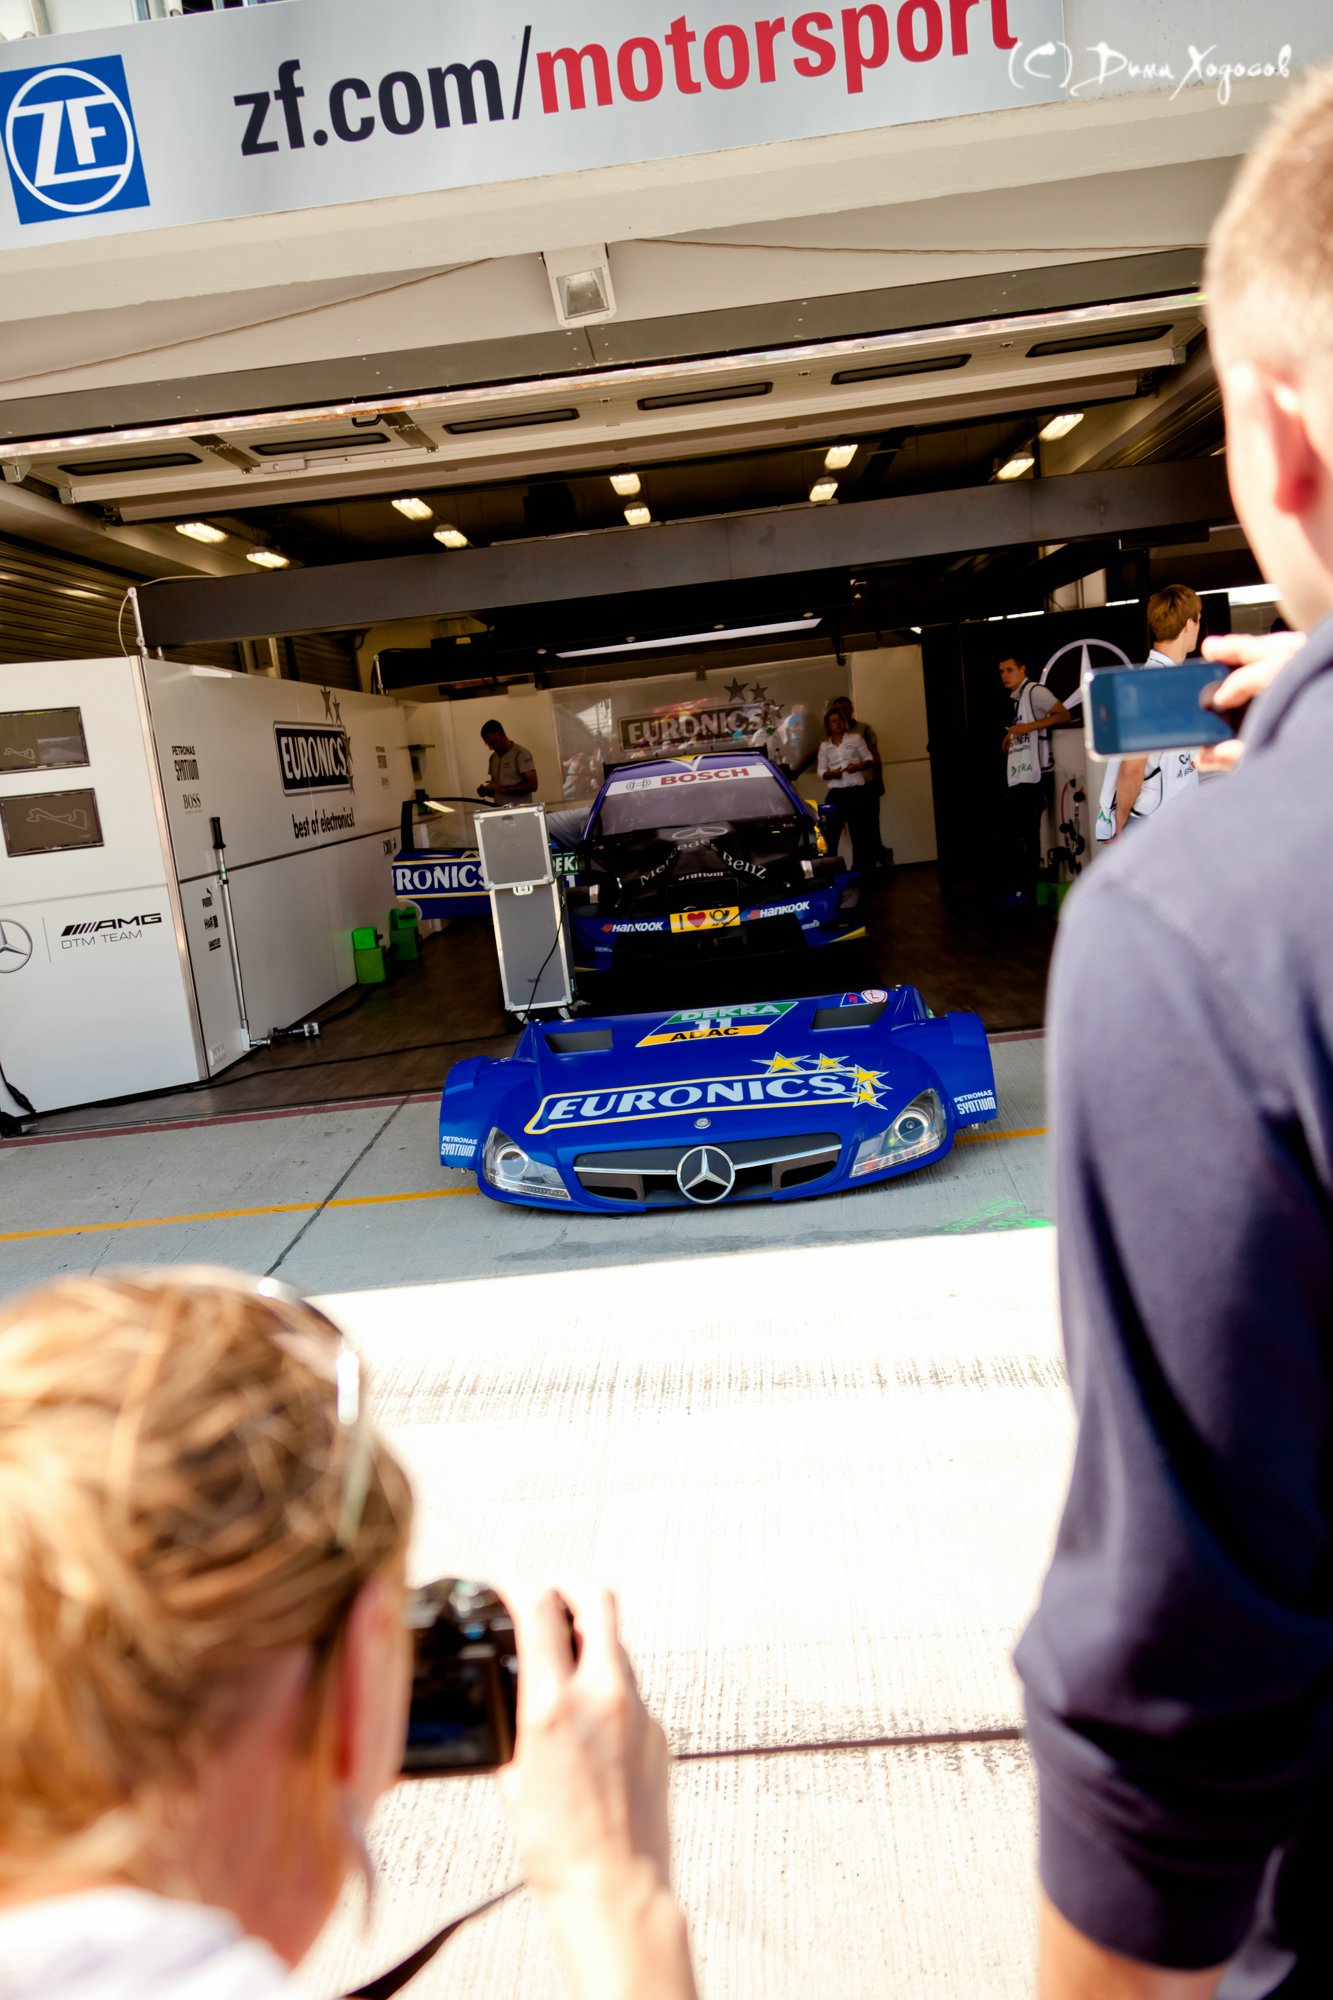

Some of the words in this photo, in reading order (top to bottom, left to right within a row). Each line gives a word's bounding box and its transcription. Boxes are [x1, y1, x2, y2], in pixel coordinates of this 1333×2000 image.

[233, 0, 1019, 157] zf.com/motorsport
[10, 93, 124, 188] ZF
[280, 735, 348, 780] EURONICS
[660, 767, 750, 787] BOSCH
[182, 792, 202, 810] BOSS
[291, 812, 311, 839] best
[311, 809, 320, 835] of
[391, 863, 486, 892] RONIC
[722, 850, 768, 880] Benz
[61, 935, 97, 950] DTM
[101, 929, 144, 944] TEAM
[681, 1004, 781, 1021] DEKRA
[694, 1017, 733, 1030] 11
[547, 1074, 848, 1121] EURONICS
[953, 1089, 993, 1104] PETRONAS
[442, 1135, 478, 1145] PETRONAS
